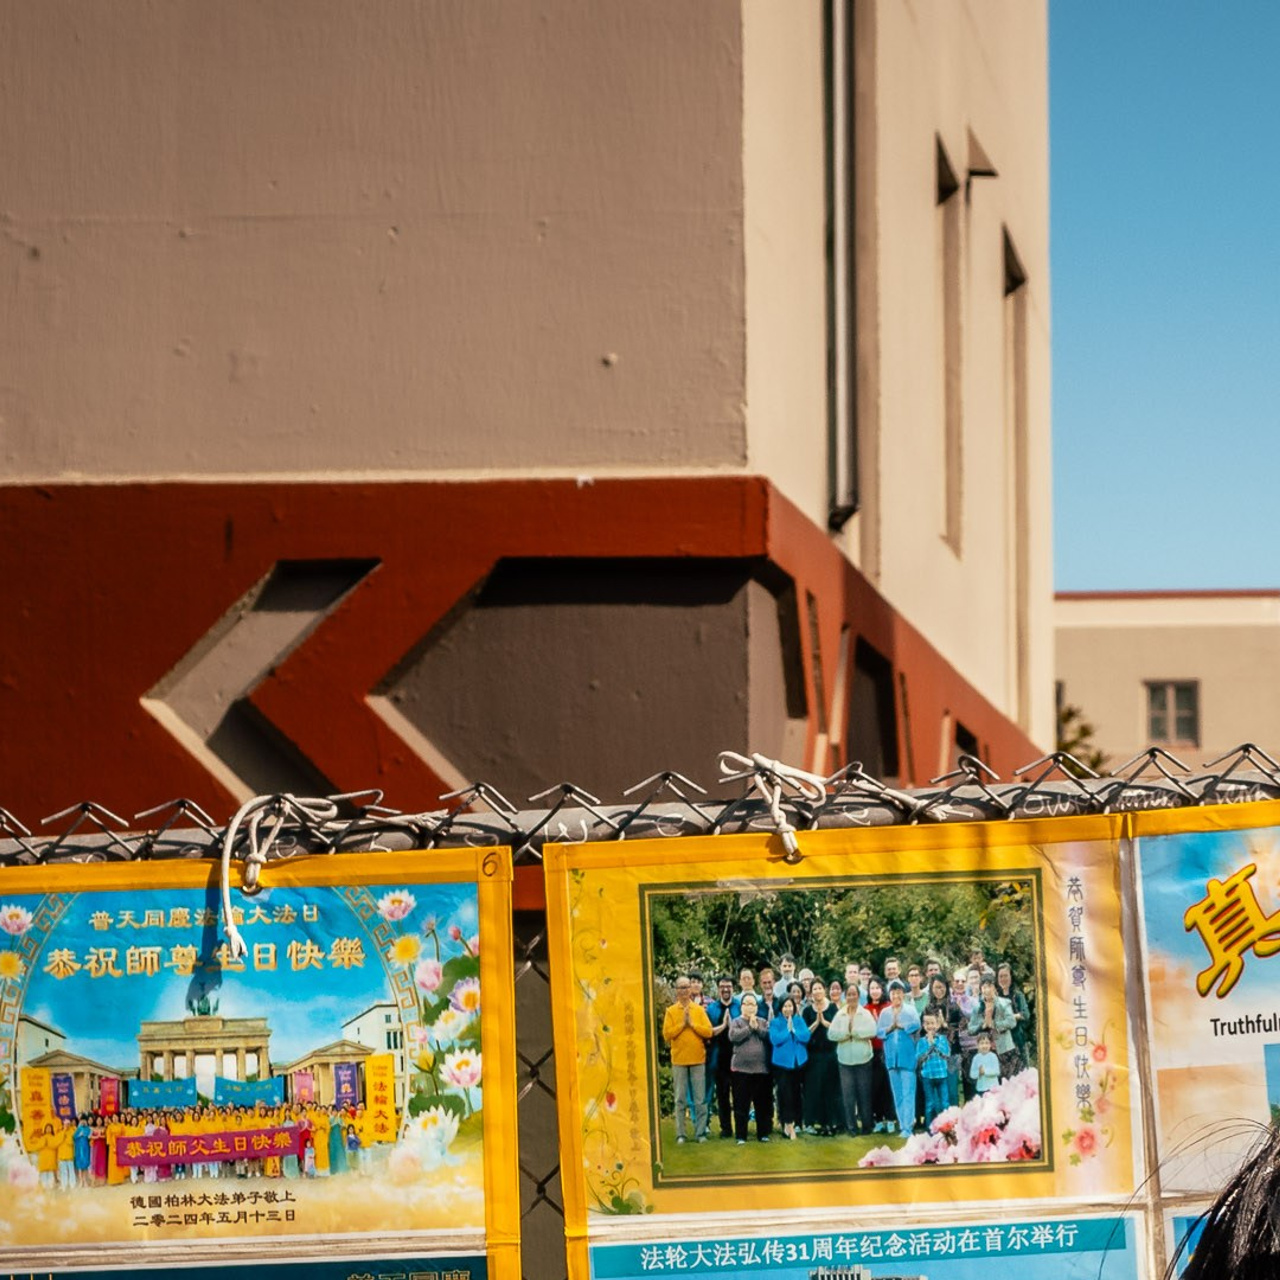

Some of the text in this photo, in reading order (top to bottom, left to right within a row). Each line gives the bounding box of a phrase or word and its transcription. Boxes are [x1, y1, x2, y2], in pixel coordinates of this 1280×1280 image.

[124, 1125, 293, 1160] 恭祝師父生日快樂
[133, 1209, 295, 1227] 二零二四年五月十三日
